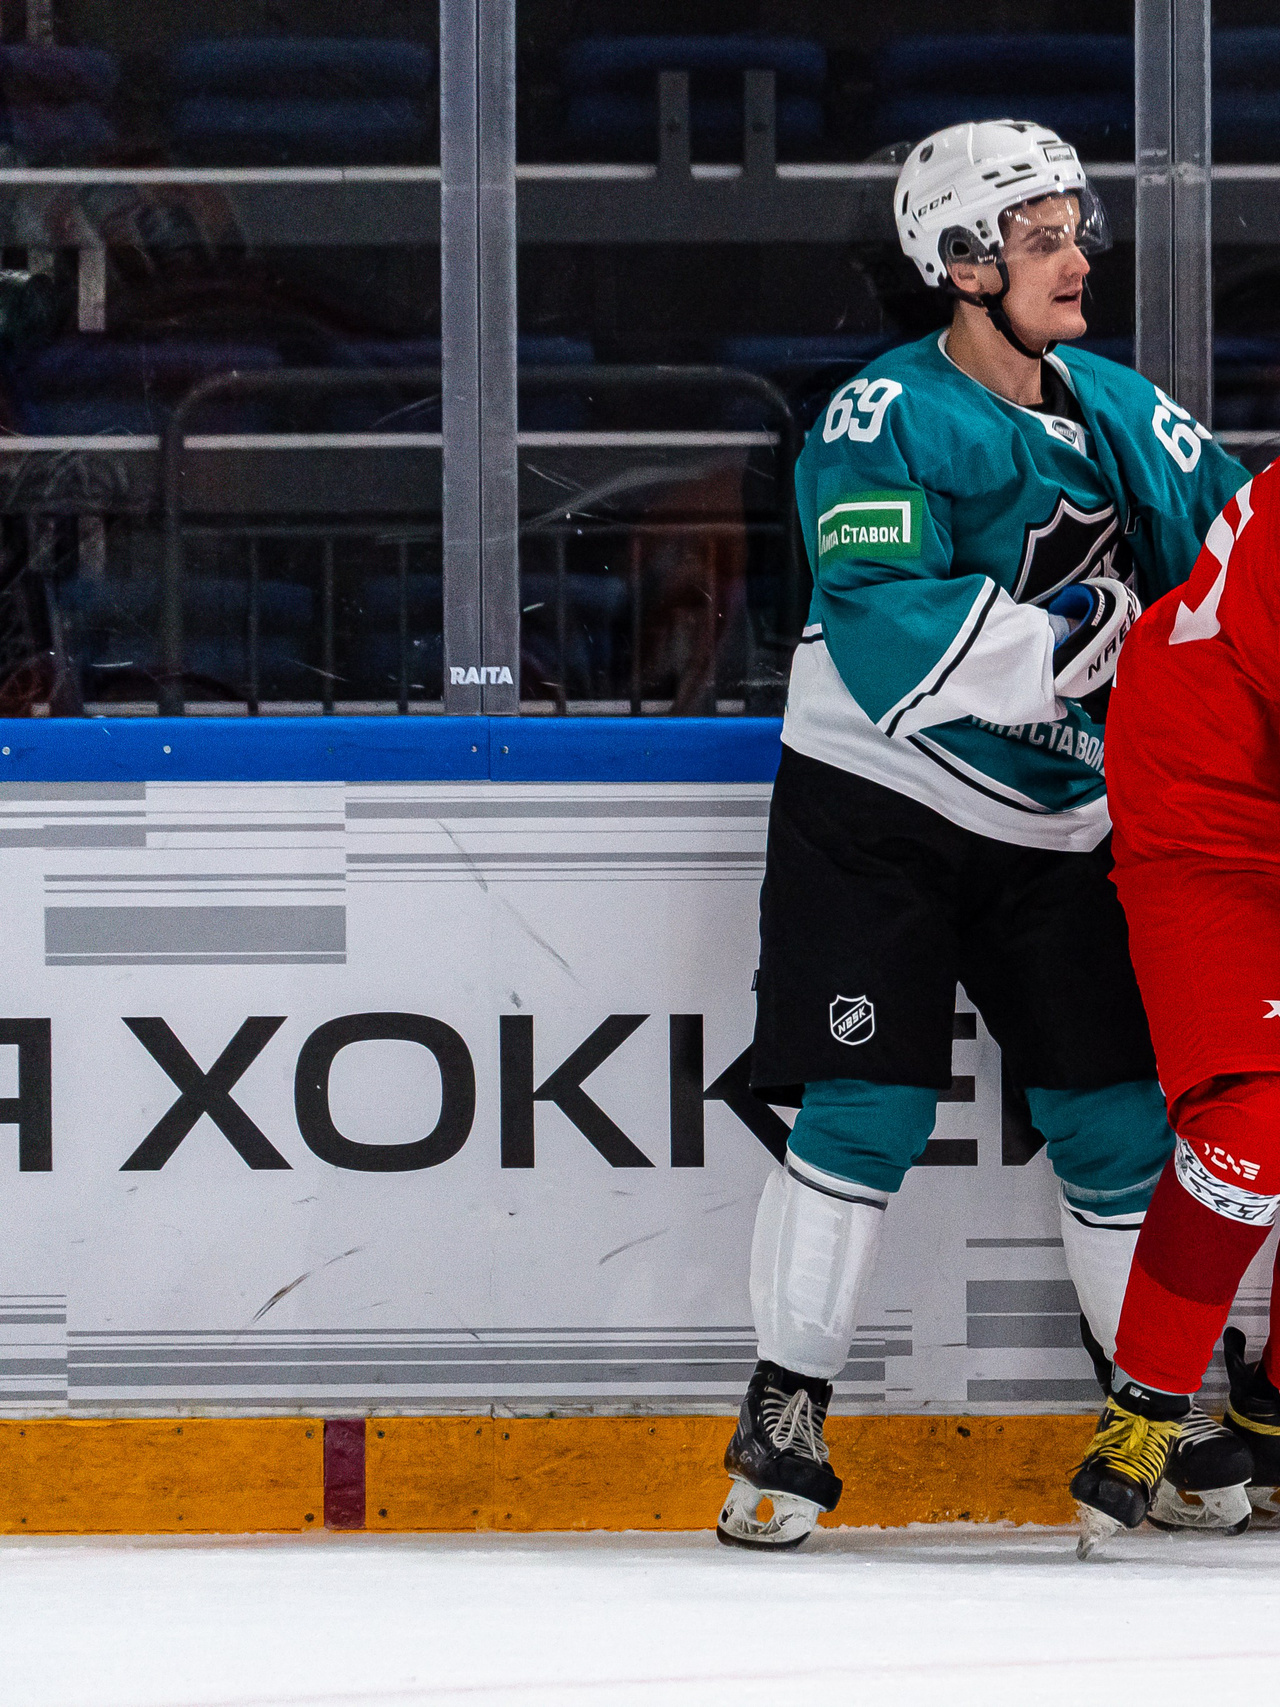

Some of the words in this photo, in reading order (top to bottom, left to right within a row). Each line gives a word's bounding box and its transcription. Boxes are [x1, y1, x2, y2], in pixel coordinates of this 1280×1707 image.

[918, 191, 952, 217] CCM
[822, 377, 903, 444] 69
[449, 666, 514, 685] RAITA
